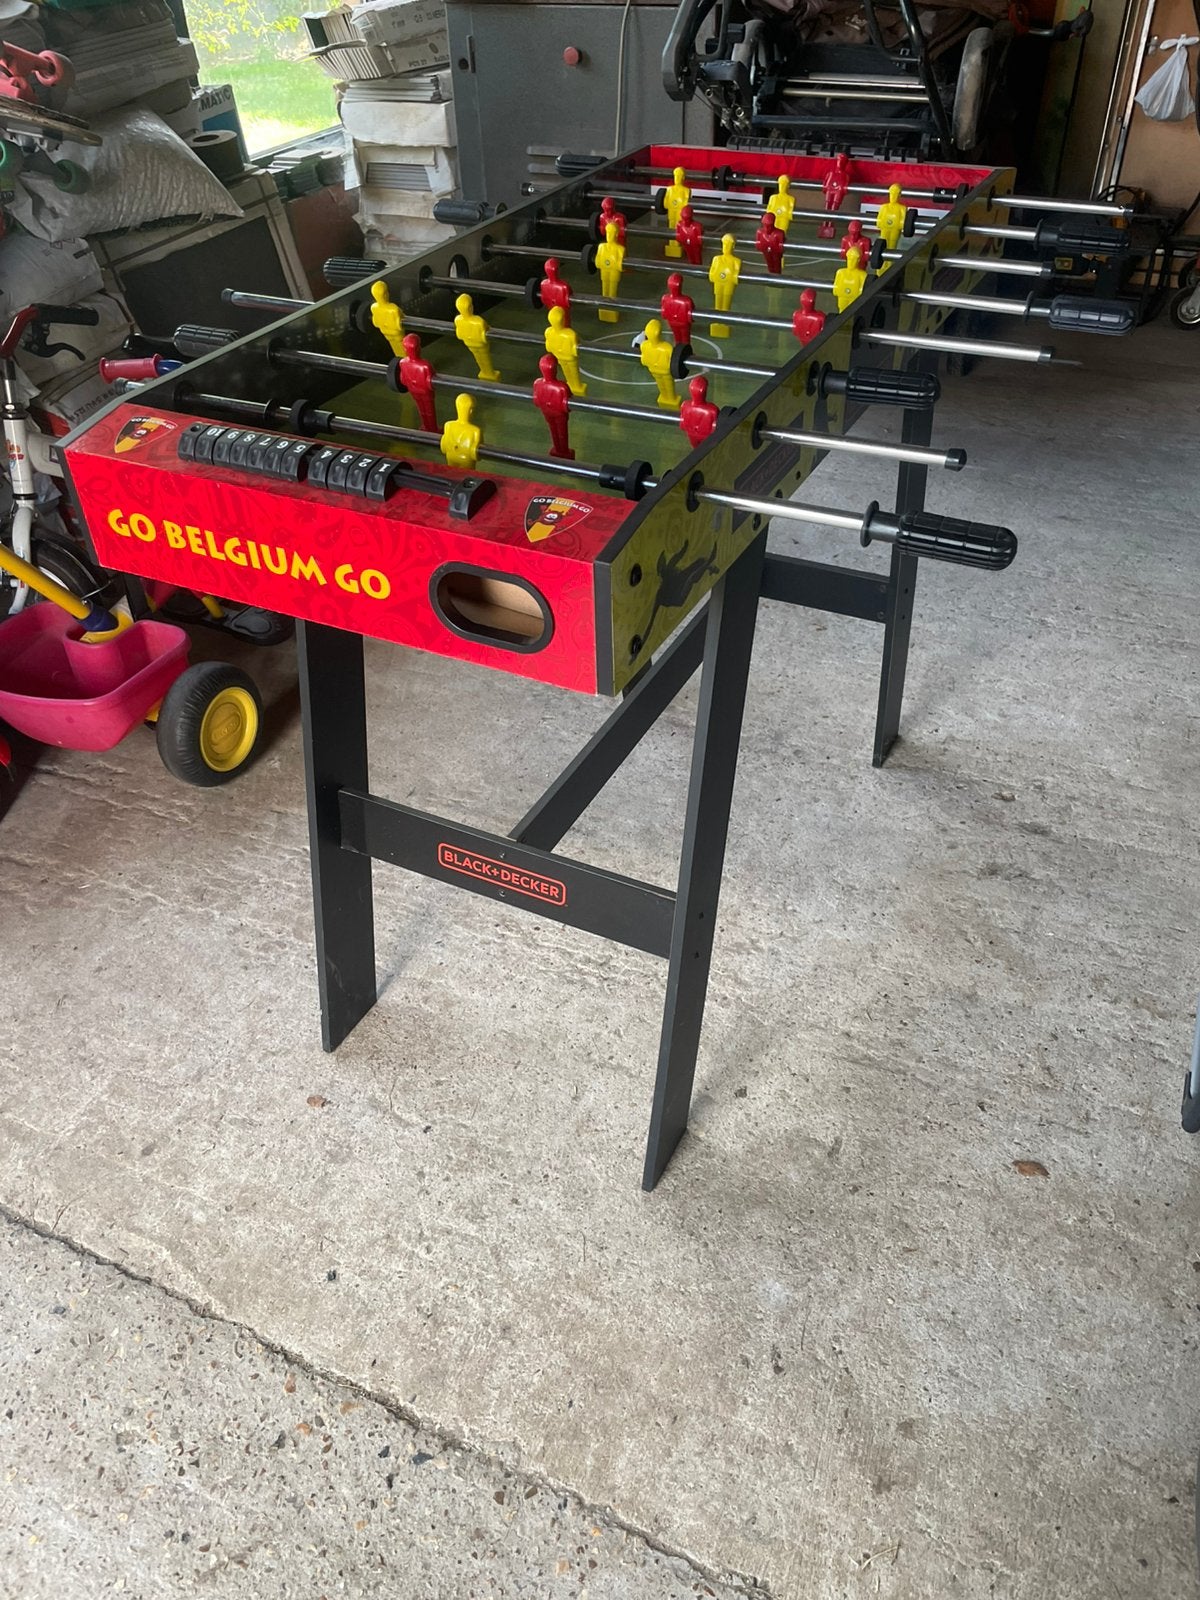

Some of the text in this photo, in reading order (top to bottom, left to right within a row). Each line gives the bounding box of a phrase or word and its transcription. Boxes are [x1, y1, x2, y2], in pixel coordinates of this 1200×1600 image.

[206, 428, 225, 436] 10
[243, 434, 256, 442] 8
[258, 437, 272, 446] 7
[293, 445, 307, 453] 5
[320, 450, 333, 459] 4
[340, 454, 353, 463] 3
[358, 458, 372, 468] 2
[546, 498, 579, 509] BELGIUM
[107, 509, 391, 600] GO BELGIUM GO
[443, 850, 560, 898] BLACK+DECKER
